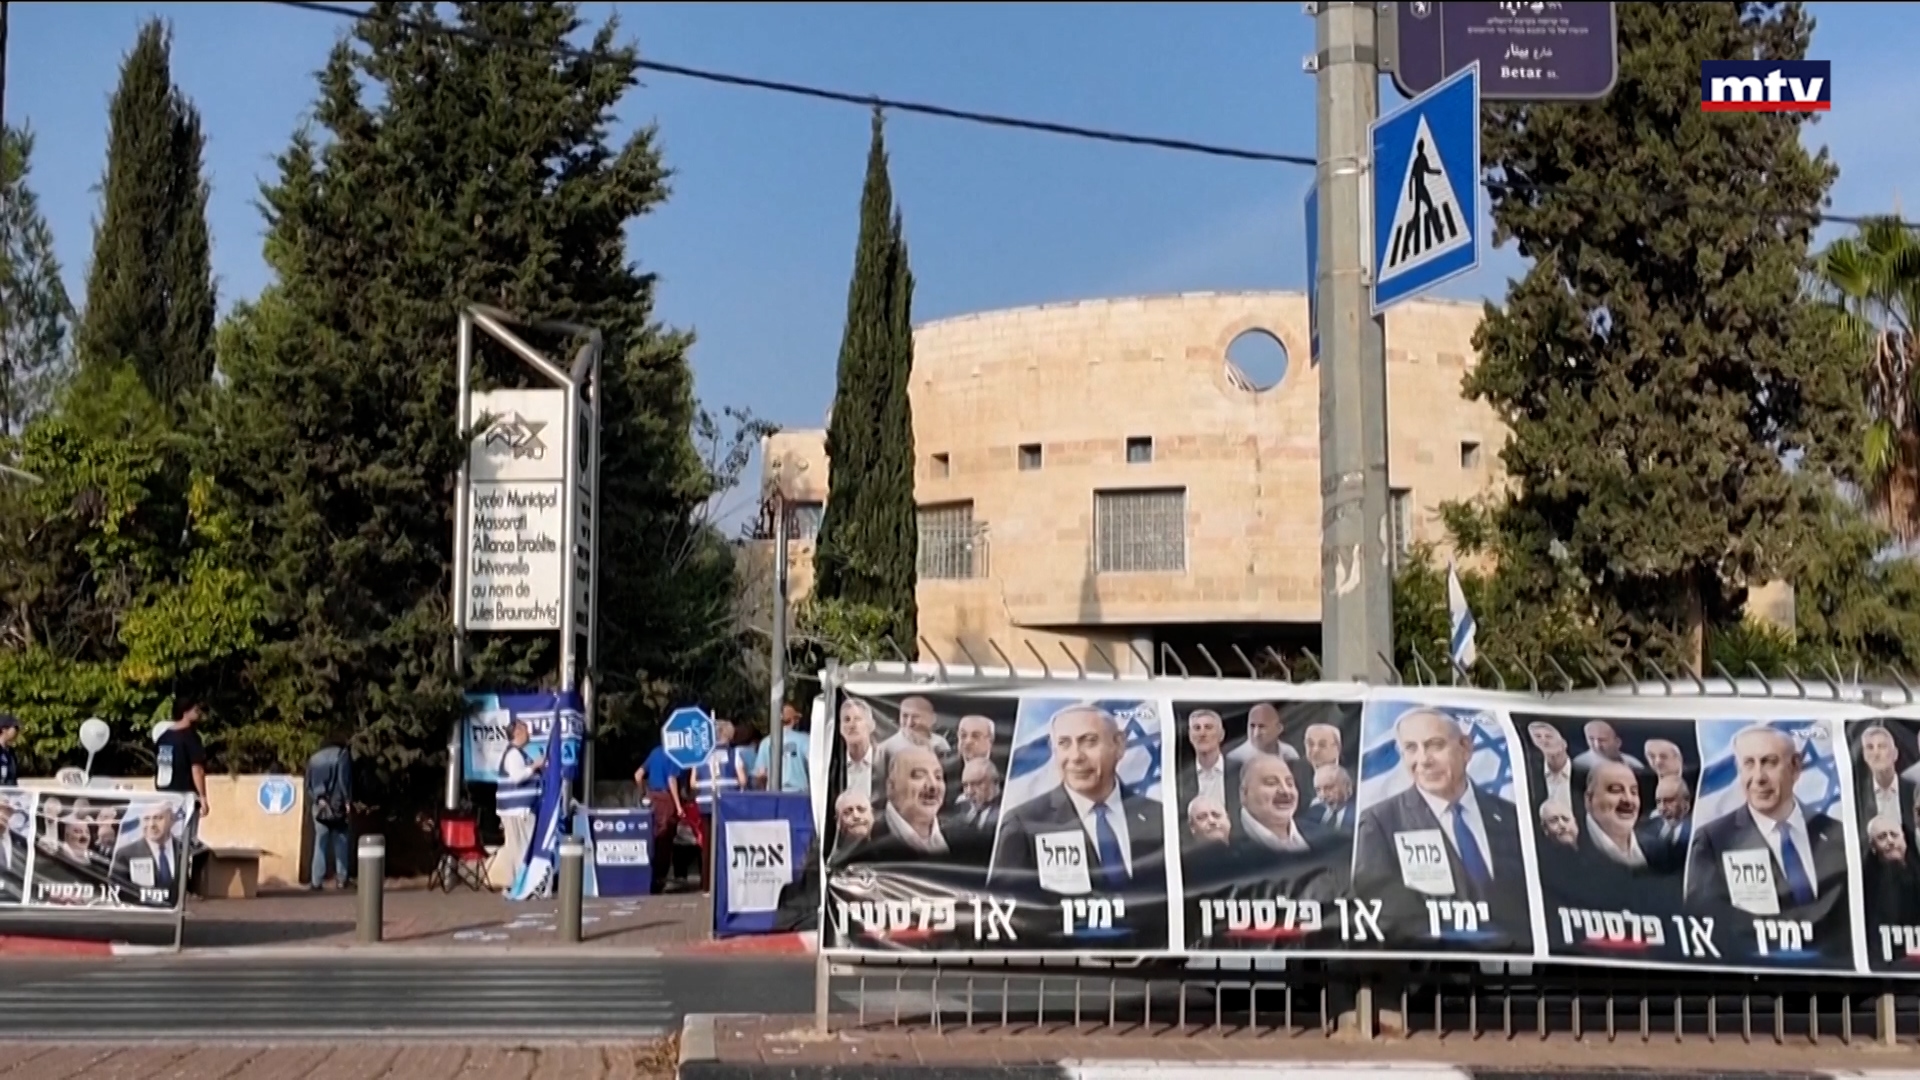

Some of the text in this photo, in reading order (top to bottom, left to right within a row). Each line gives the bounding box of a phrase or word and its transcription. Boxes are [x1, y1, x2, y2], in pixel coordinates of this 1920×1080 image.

[1501, 66, 1542, 78] Betar
[472, 578, 530, 598] au nom de
[732, 844, 784, 869] אמת
[1041, 837, 1081, 867] מחל
[1400, 836, 1441, 865] מחל
[1729, 856, 1767, 884] מחל
[836, 895, 1125, 940] ימין או פלסטין
[1199, 895, 1490, 942] ימין או פלסטין
[1557, 906, 1814, 959] ימין או פלסטין
